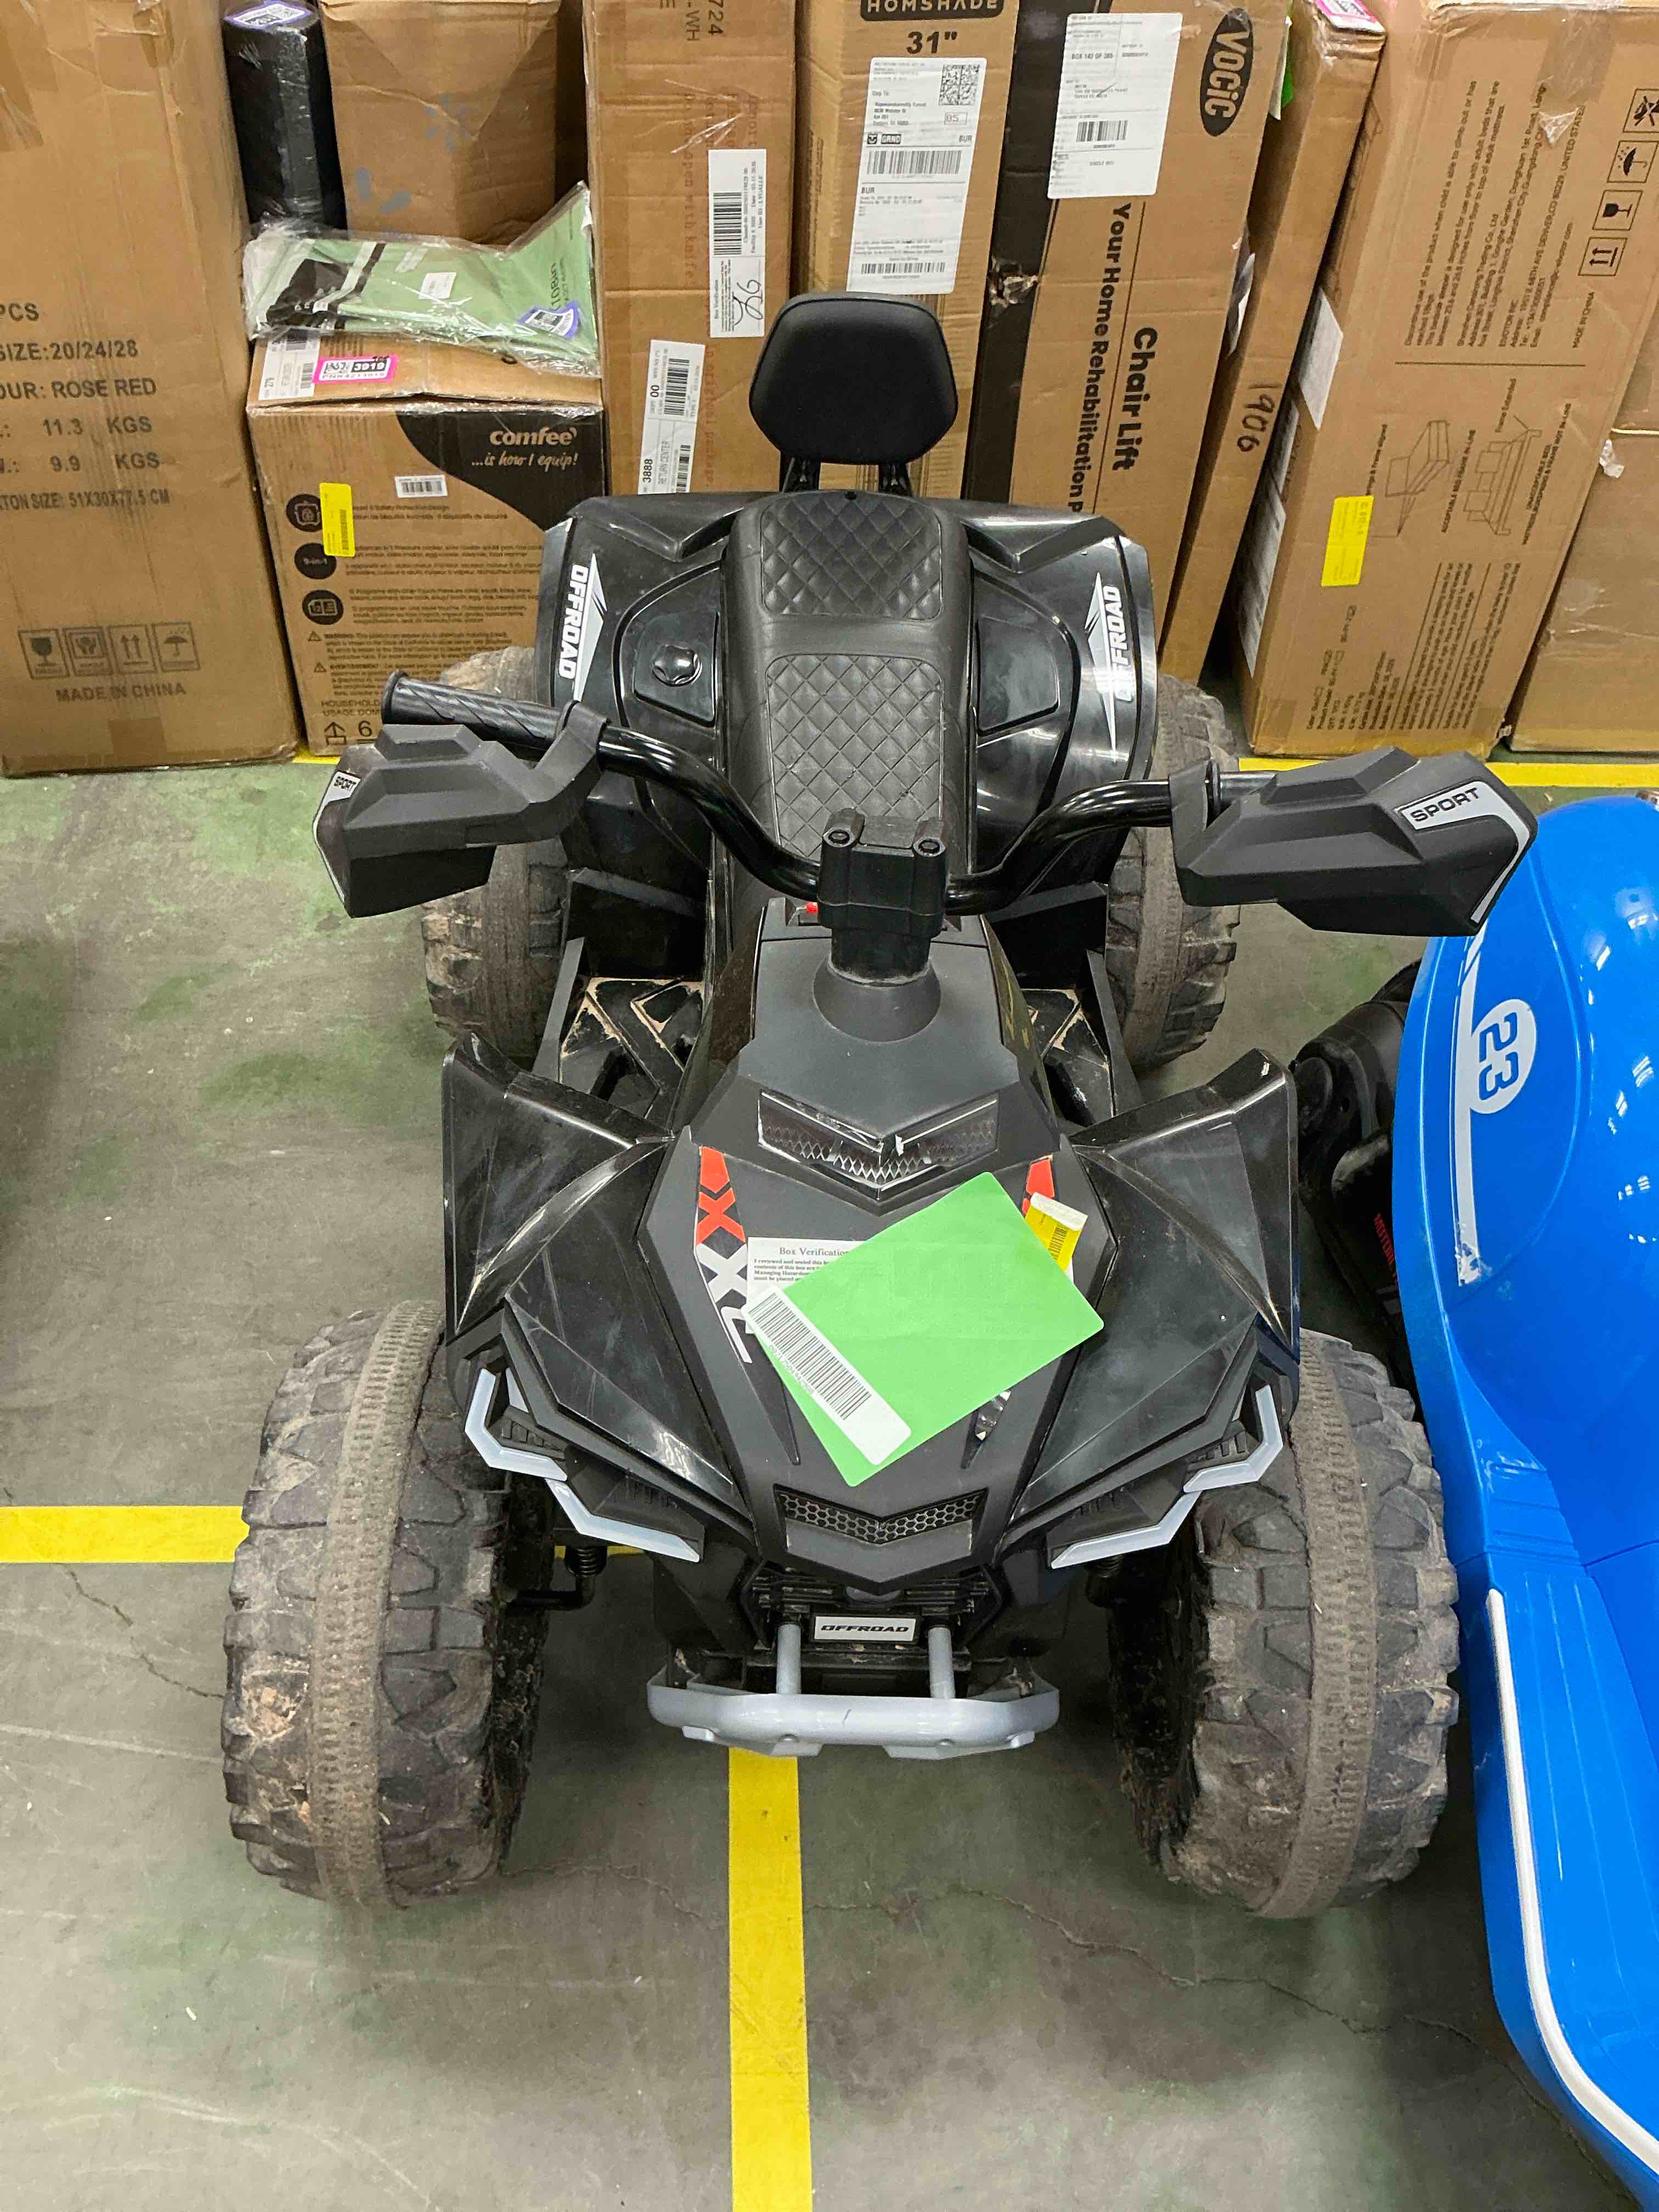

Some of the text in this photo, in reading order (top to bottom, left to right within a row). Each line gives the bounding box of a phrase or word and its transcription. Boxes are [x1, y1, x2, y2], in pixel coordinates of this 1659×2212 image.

[906, 31, 957, 54] 31"
[1071, 202, 1131, 495] Your Home Rehabilitation
[52, 380, 108, 398] ROSE
[114, 377, 157, 397] RED
[1111, 328, 1158, 471] Chair Lift
[43, 416, 152, 436] 11.3 KGS
[50, 452, 160, 472] 9.9 KGS
[642, 459, 652, 482] 3888
[558, 562, 589, 680] OFFROAD
[132, 682, 187, 698] CHINA
[1410, 786, 1480, 823] SPORT
[1479, 1011, 1519, 1101] 23
[821, 1624, 910, 1634] OFFROAD
